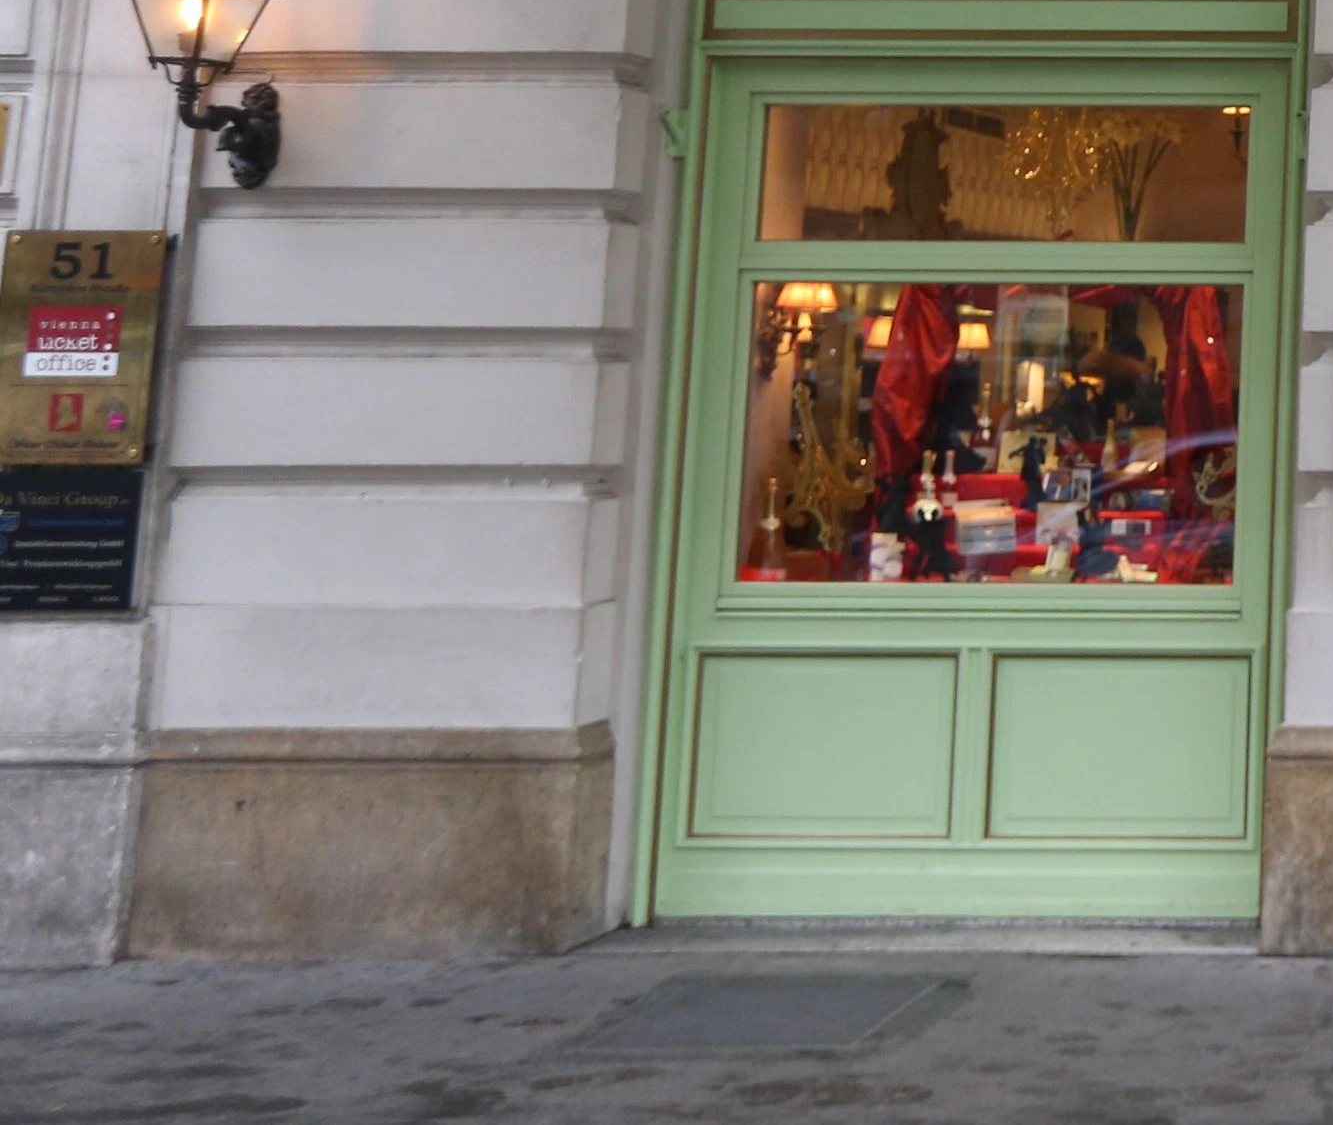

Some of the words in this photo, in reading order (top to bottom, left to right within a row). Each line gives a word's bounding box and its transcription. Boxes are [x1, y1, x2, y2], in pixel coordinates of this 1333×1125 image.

[50, 241, 113, 280] 51
[40, 320, 101, 330] vienna
[36, 354, 97, 371] office
